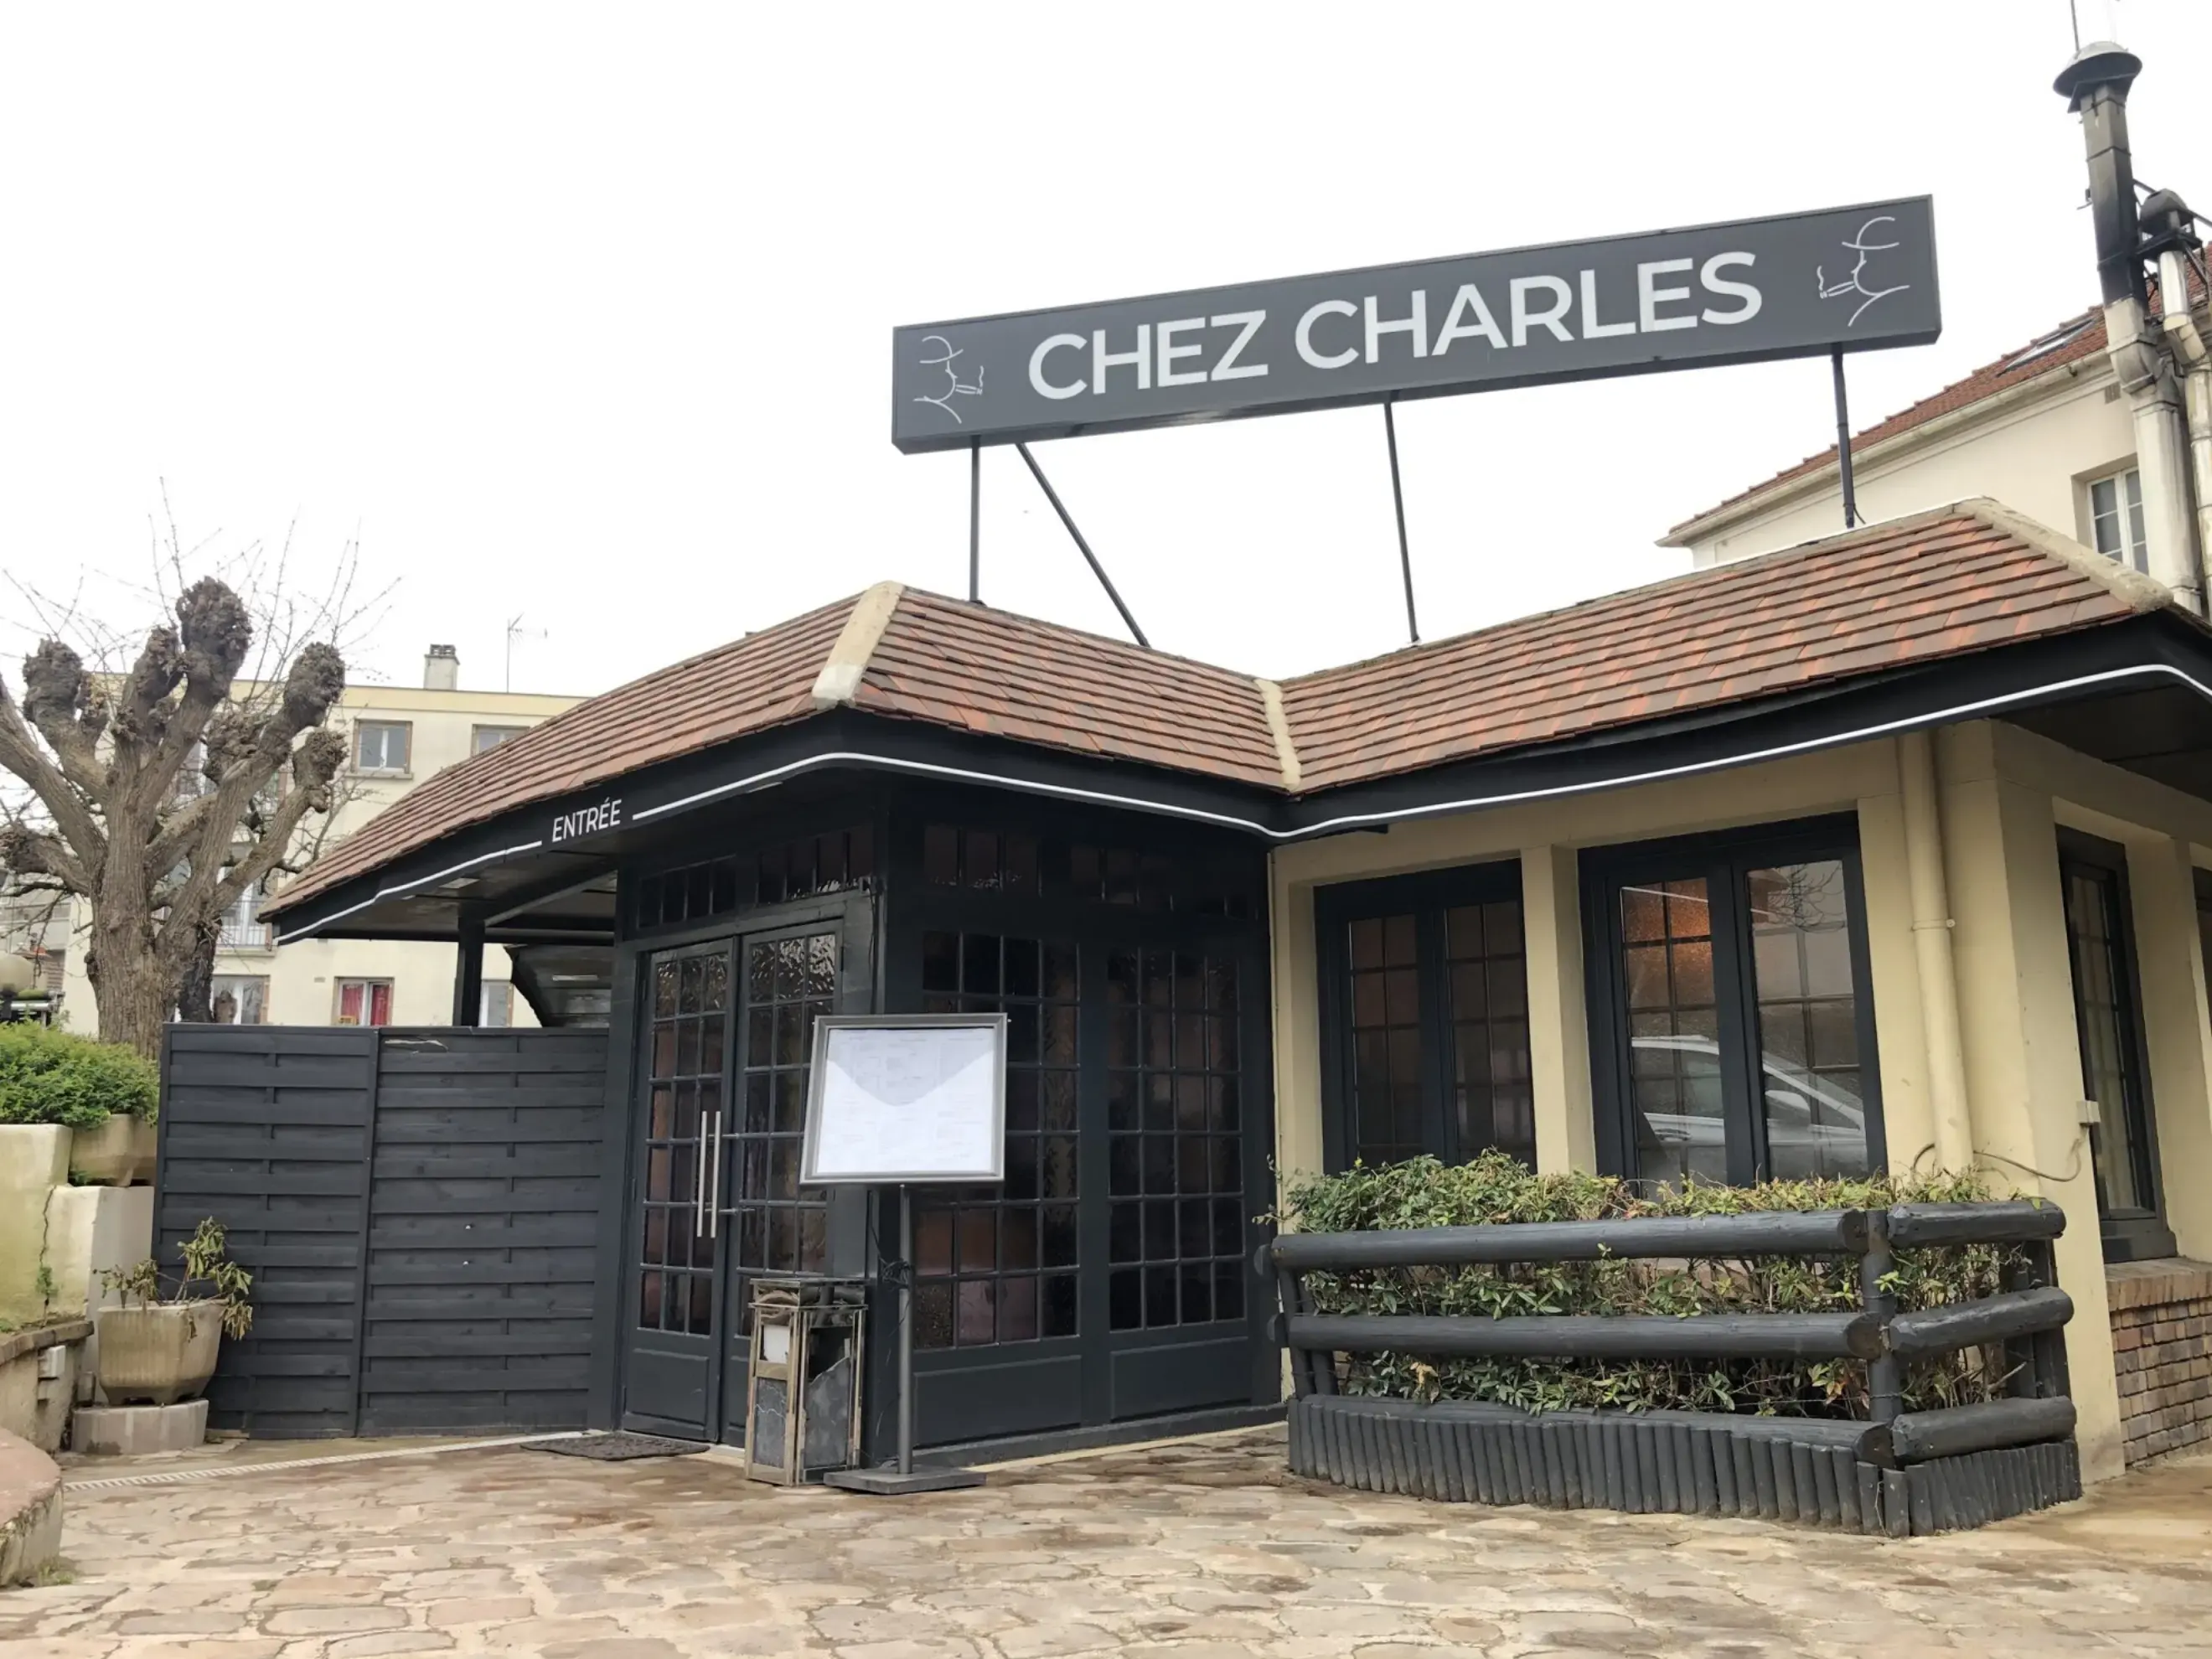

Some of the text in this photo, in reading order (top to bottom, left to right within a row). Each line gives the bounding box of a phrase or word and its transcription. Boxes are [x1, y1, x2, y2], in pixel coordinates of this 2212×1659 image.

[1028, 251, 1762, 400] CHEZ CHARLES
[551, 796, 622, 843] ENTRÉE
